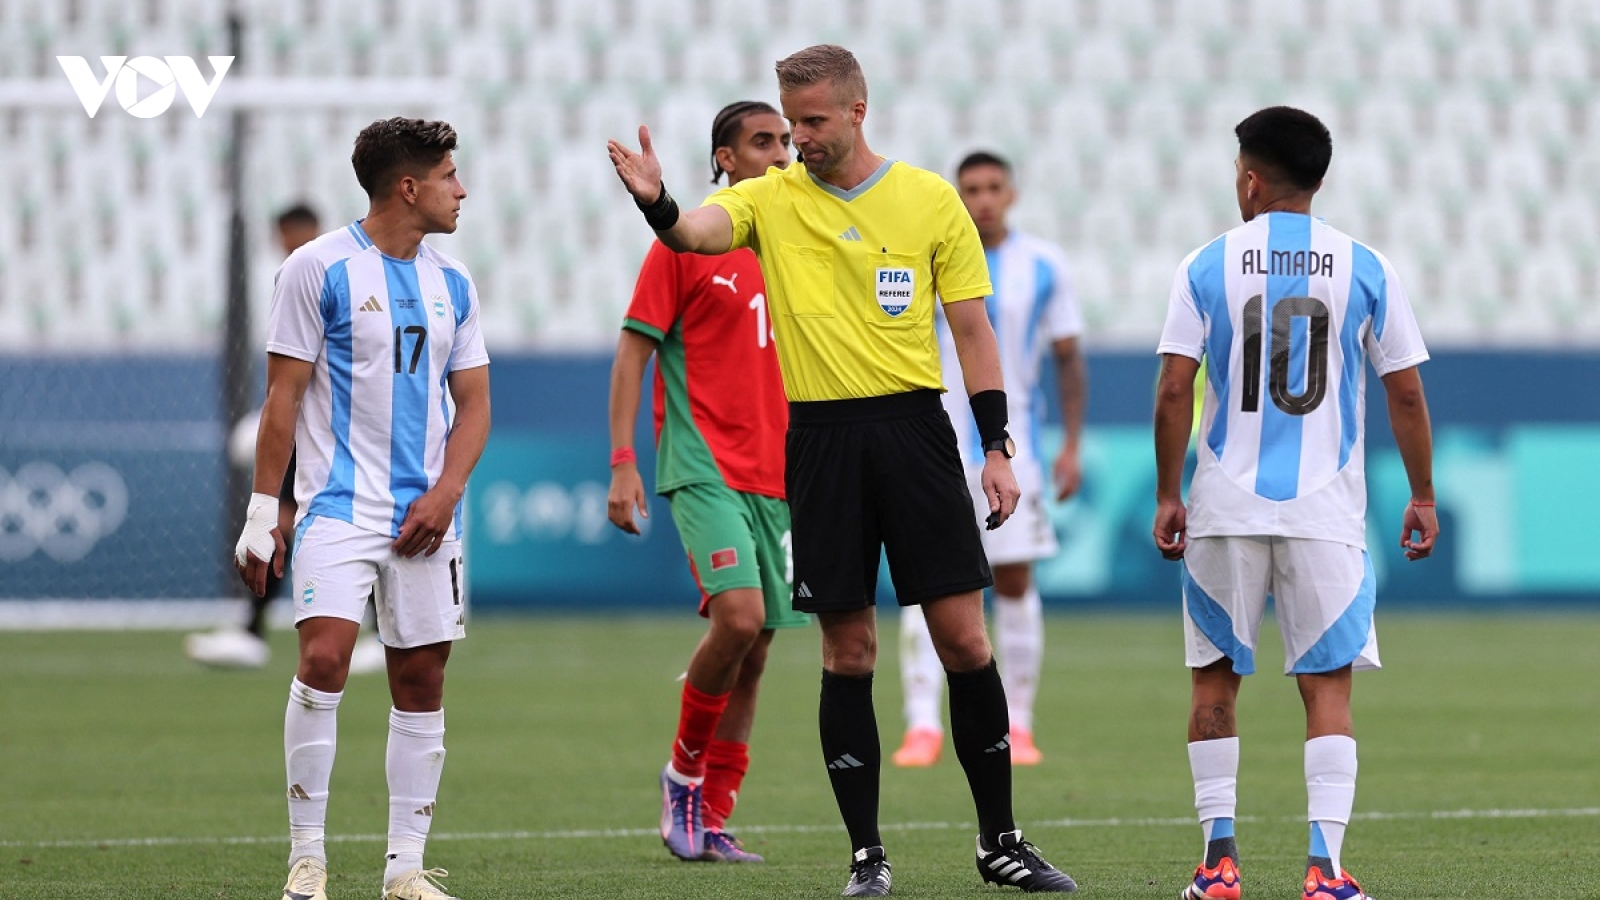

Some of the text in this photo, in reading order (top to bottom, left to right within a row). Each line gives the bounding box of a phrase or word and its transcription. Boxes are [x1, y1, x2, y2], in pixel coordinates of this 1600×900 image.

[879, 270, 912, 283] FIFA
[1242, 249, 1334, 278] ALMADA
[879, 290, 911, 298] REFEREE
[748, 292, 776, 349] 1
[394, 325, 428, 375] 17
[1240, 293, 1330, 417] 10
[448, 556, 465, 606] 1
